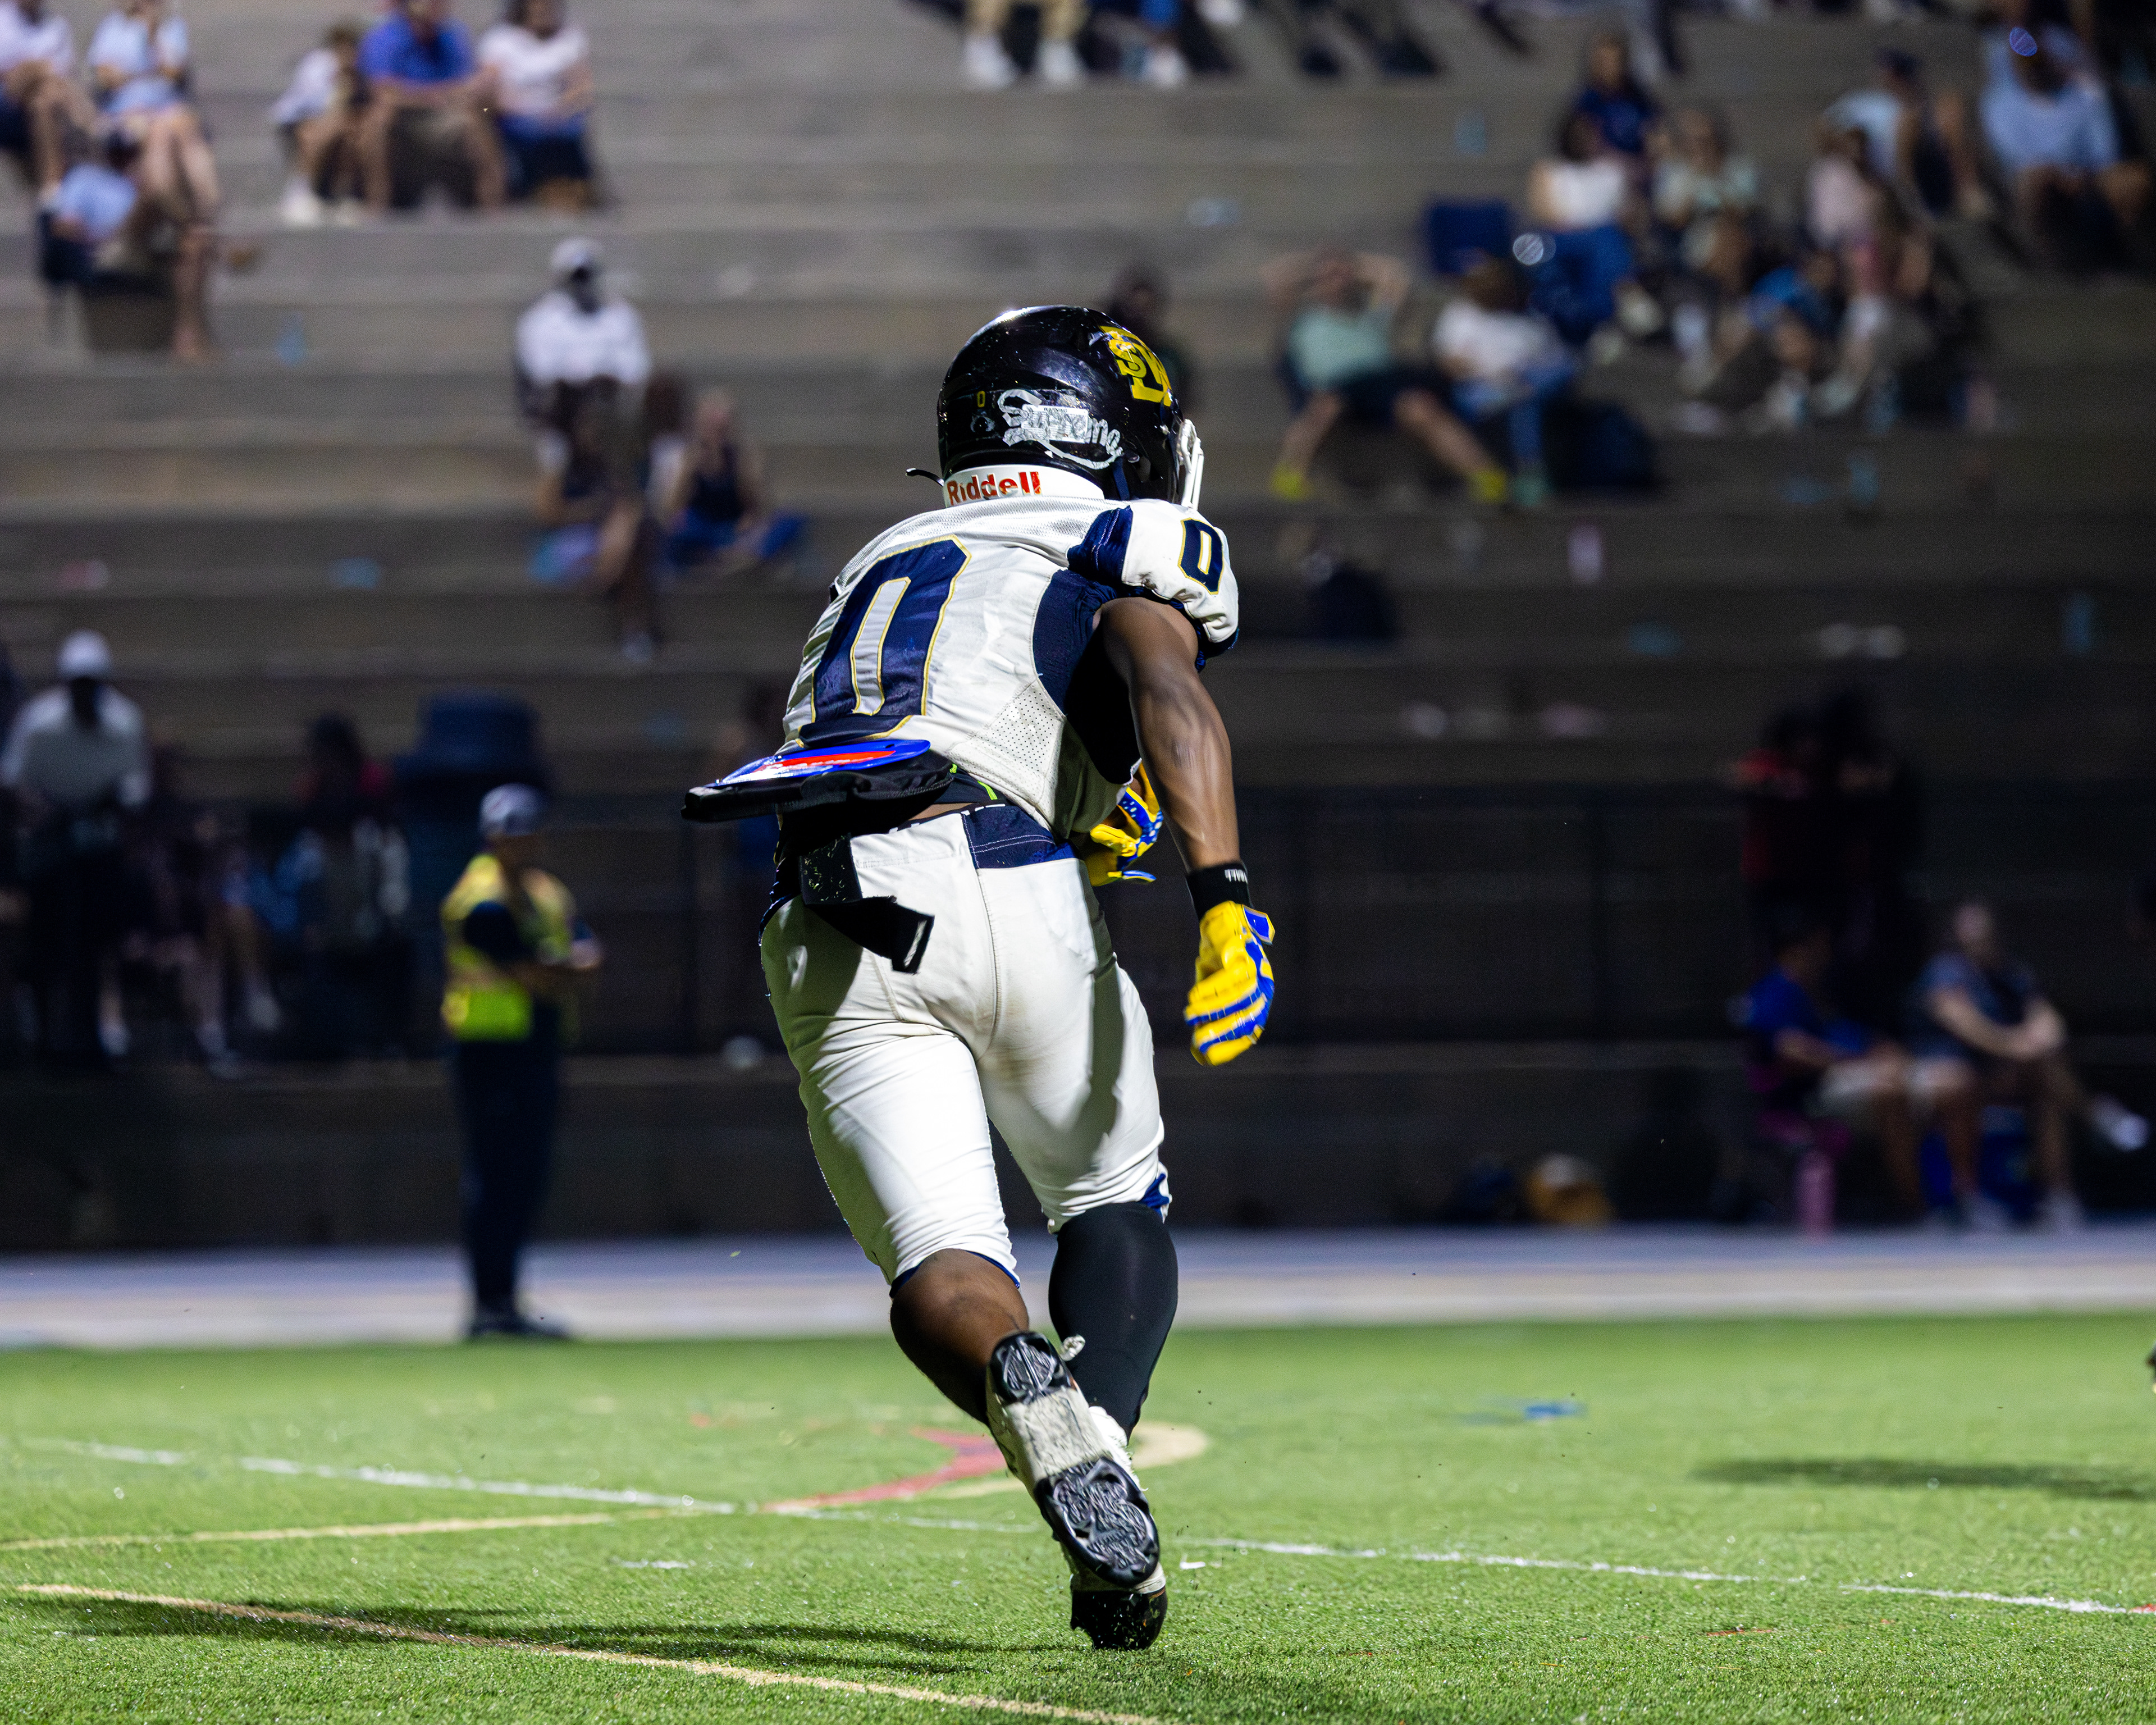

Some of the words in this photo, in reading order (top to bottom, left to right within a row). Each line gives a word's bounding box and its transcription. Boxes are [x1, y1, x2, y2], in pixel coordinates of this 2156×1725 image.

[947, 471, 1043, 506] Riddell
[1177, 517, 1224, 595] 0
[798, 533, 972, 748] 0
